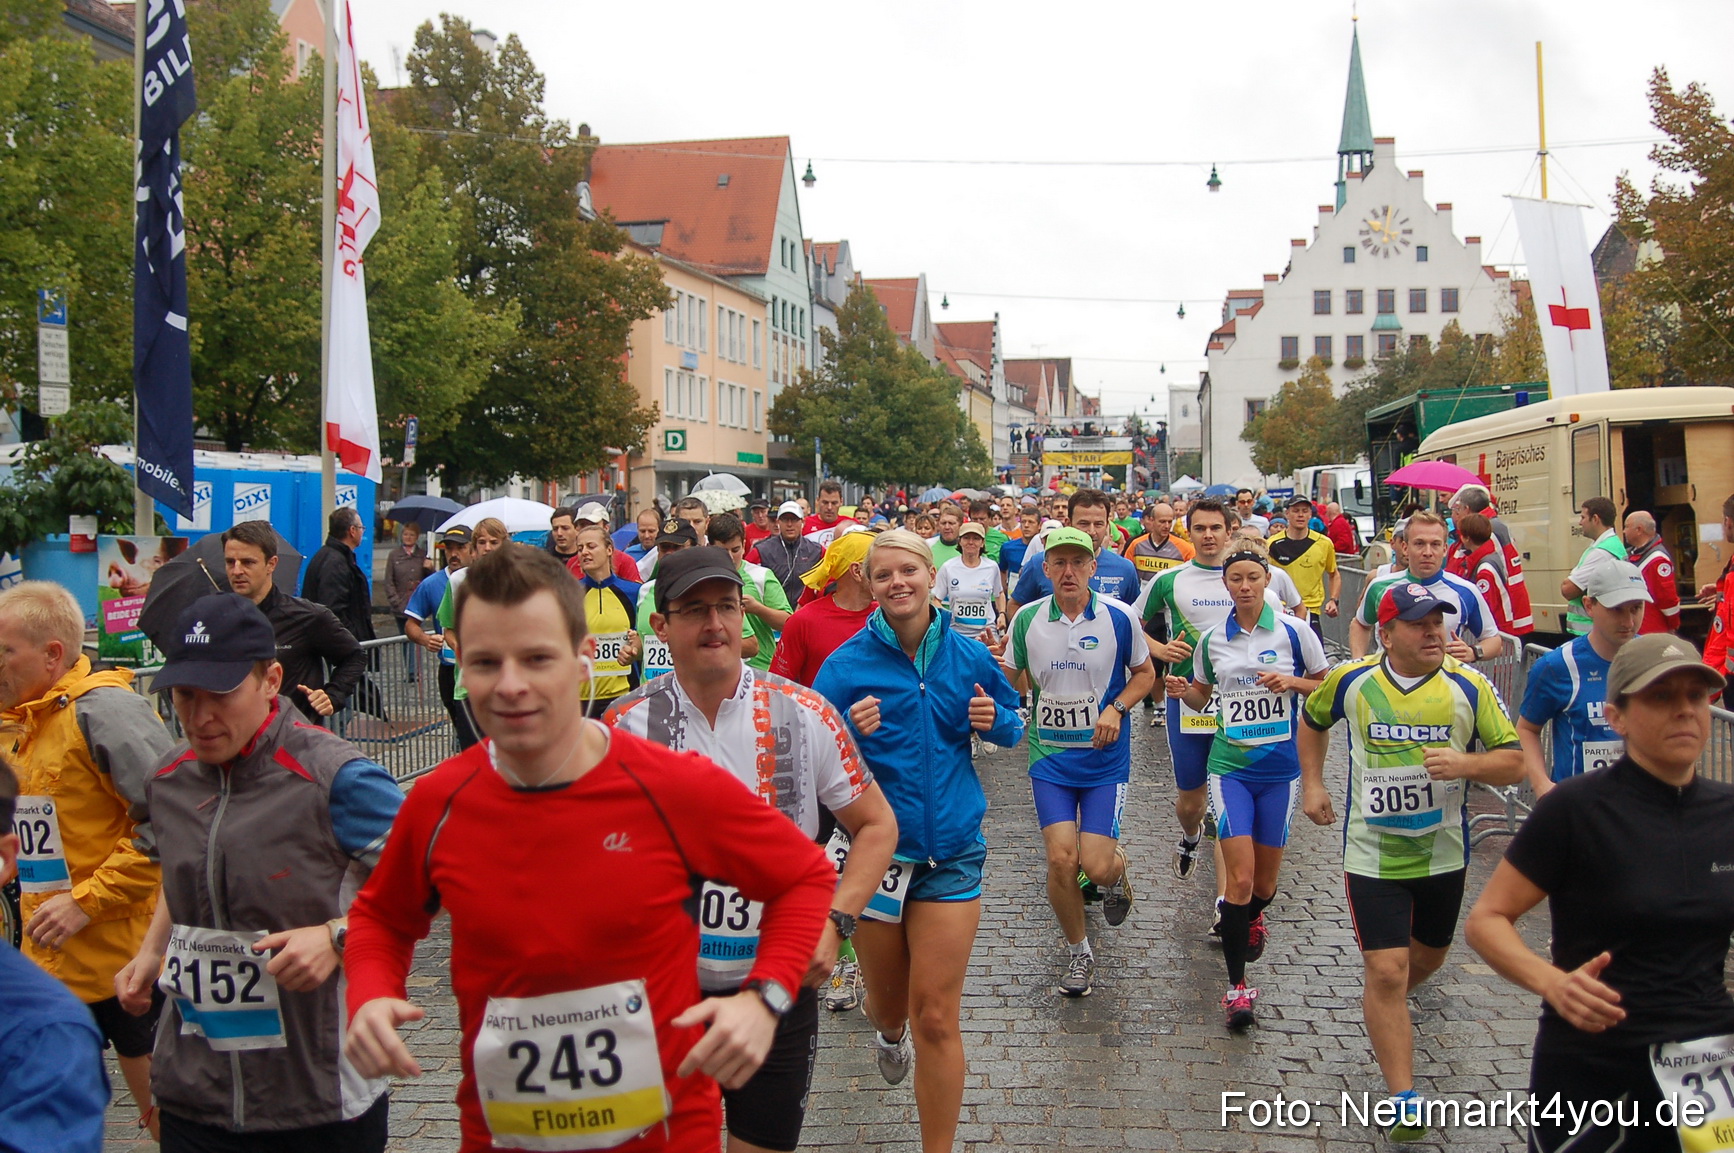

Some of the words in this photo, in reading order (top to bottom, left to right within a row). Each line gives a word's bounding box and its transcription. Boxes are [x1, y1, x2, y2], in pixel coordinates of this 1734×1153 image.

[667, 432, 684, 449] D
[1072, 454, 1102, 463] START
[1495, 444, 1546, 471] Bayerisches
[1495, 473, 1519, 492] Rotes
[957, 605, 985, 617] 3096
[1192, 598, 1234, 607] Sebastia
[131, 608, 142, 617] ST
[1051, 660, 1086, 671] Helmut
[1237, 675, 1260, 686] Heid
[1041, 706, 1090, 727] 2811
[1230, 696, 1284, 723] 2804
[1053, 731, 1083, 740] Helmut
[1241, 726, 1276, 737] Heidrun
[1369, 723, 1451, 742] BOCK
[1363, 775, 1387, 783] PARTL
[1388, 773, 1428, 782] Neumarkt
[1369, 782, 1434, 814] 3051
[12, 820, 54, 856] 02
[19, 866, 35, 879] rnst
[881, 864, 903, 893] 3
[702, 890, 750, 931] 03
[189, 940, 247, 955] Neumarkt
[699, 940, 754, 956] atthias
[168, 956, 264, 1004] 3152
[486, 1014, 528, 1031] PARTL
[532, 1003, 619, 1028] Neumarkt
[508, 1028, 623, 1093] 243
[1681, 1065, 1734, 1113] 31
[532, 1107, 616, 1131] Florian
